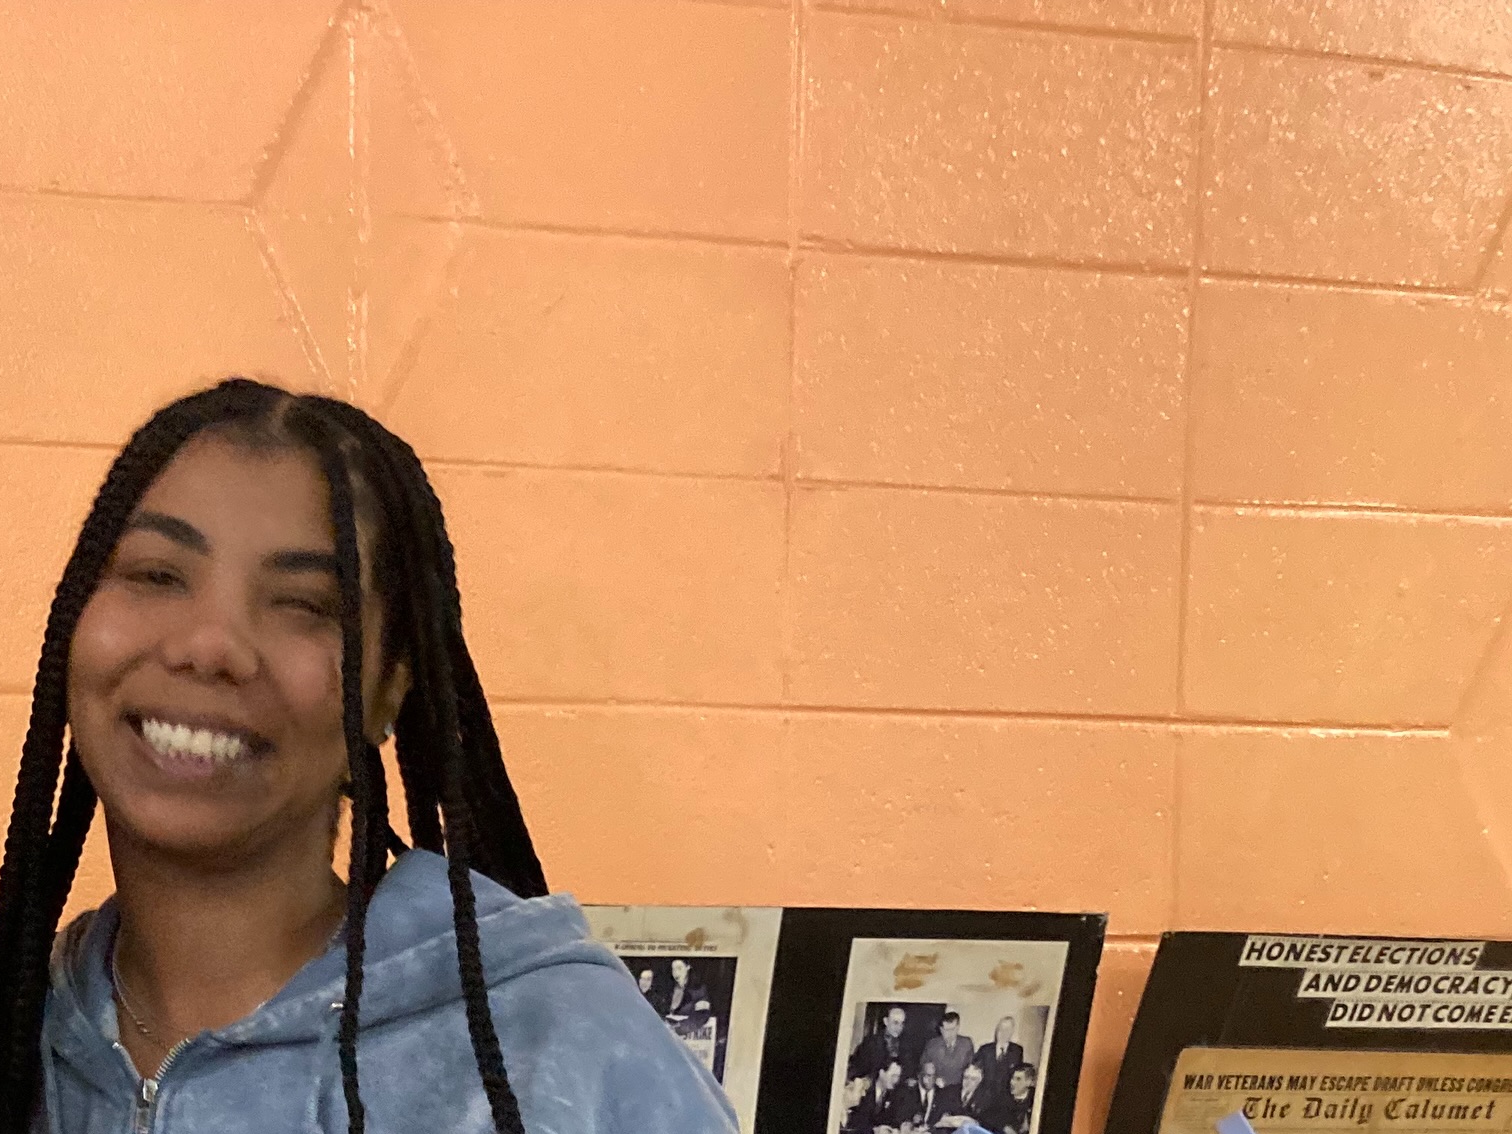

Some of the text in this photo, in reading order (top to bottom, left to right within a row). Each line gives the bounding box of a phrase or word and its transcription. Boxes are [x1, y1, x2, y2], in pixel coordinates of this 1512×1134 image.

[1245, 942, 1480, 965] HONEST ELECTIONS
[1304, 974, 1512, 995] AND DEMOCRACY
[1330, 1003, 1376, 1022] DID
[1377, 1004, 1431, 1022] NOT
[1432, 1004, 1501, 1023] COME
[1184, 1074, 1215, 1090] WAR
[1216, 1074, 1284, 1091] VETERANS
[1286, 1075, 1317, 1091] MAY
[1319, 1076, 1372, 1091] ESCAPE
[1242, 1096, 1496, 1125] The Daily Calumet
